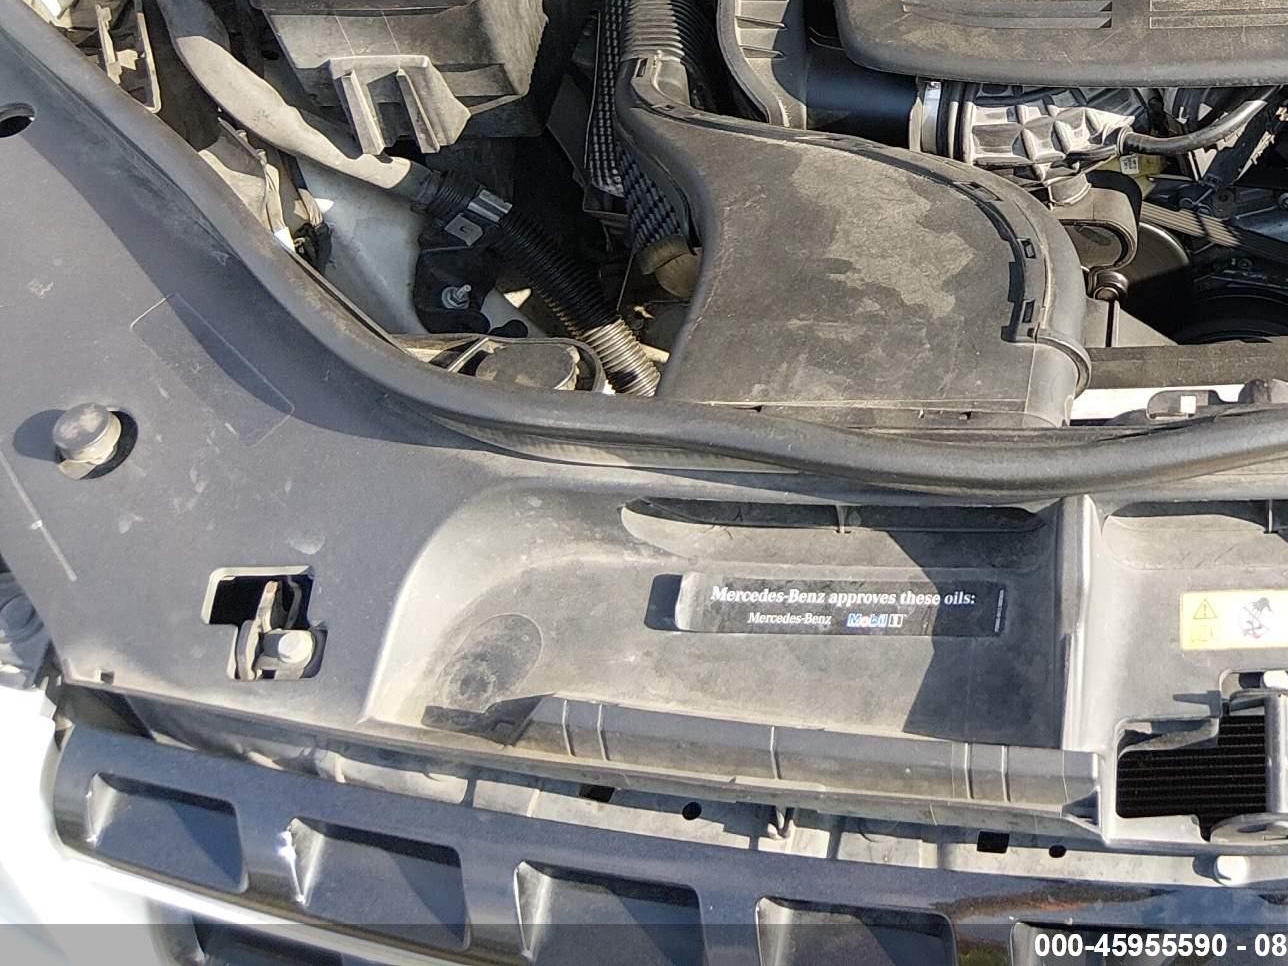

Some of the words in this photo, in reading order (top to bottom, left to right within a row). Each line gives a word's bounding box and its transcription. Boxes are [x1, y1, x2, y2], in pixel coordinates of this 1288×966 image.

[710, 585, 826, 603] Mercedes-Benz
[828, 592, 897, 607] approves
[900, 590, 941, 605] these
[943, 590, 976, 605] oils:
[747, 612, 833, 625] Mercedes-Benz
[846, 613, 889, 628] Mobil
